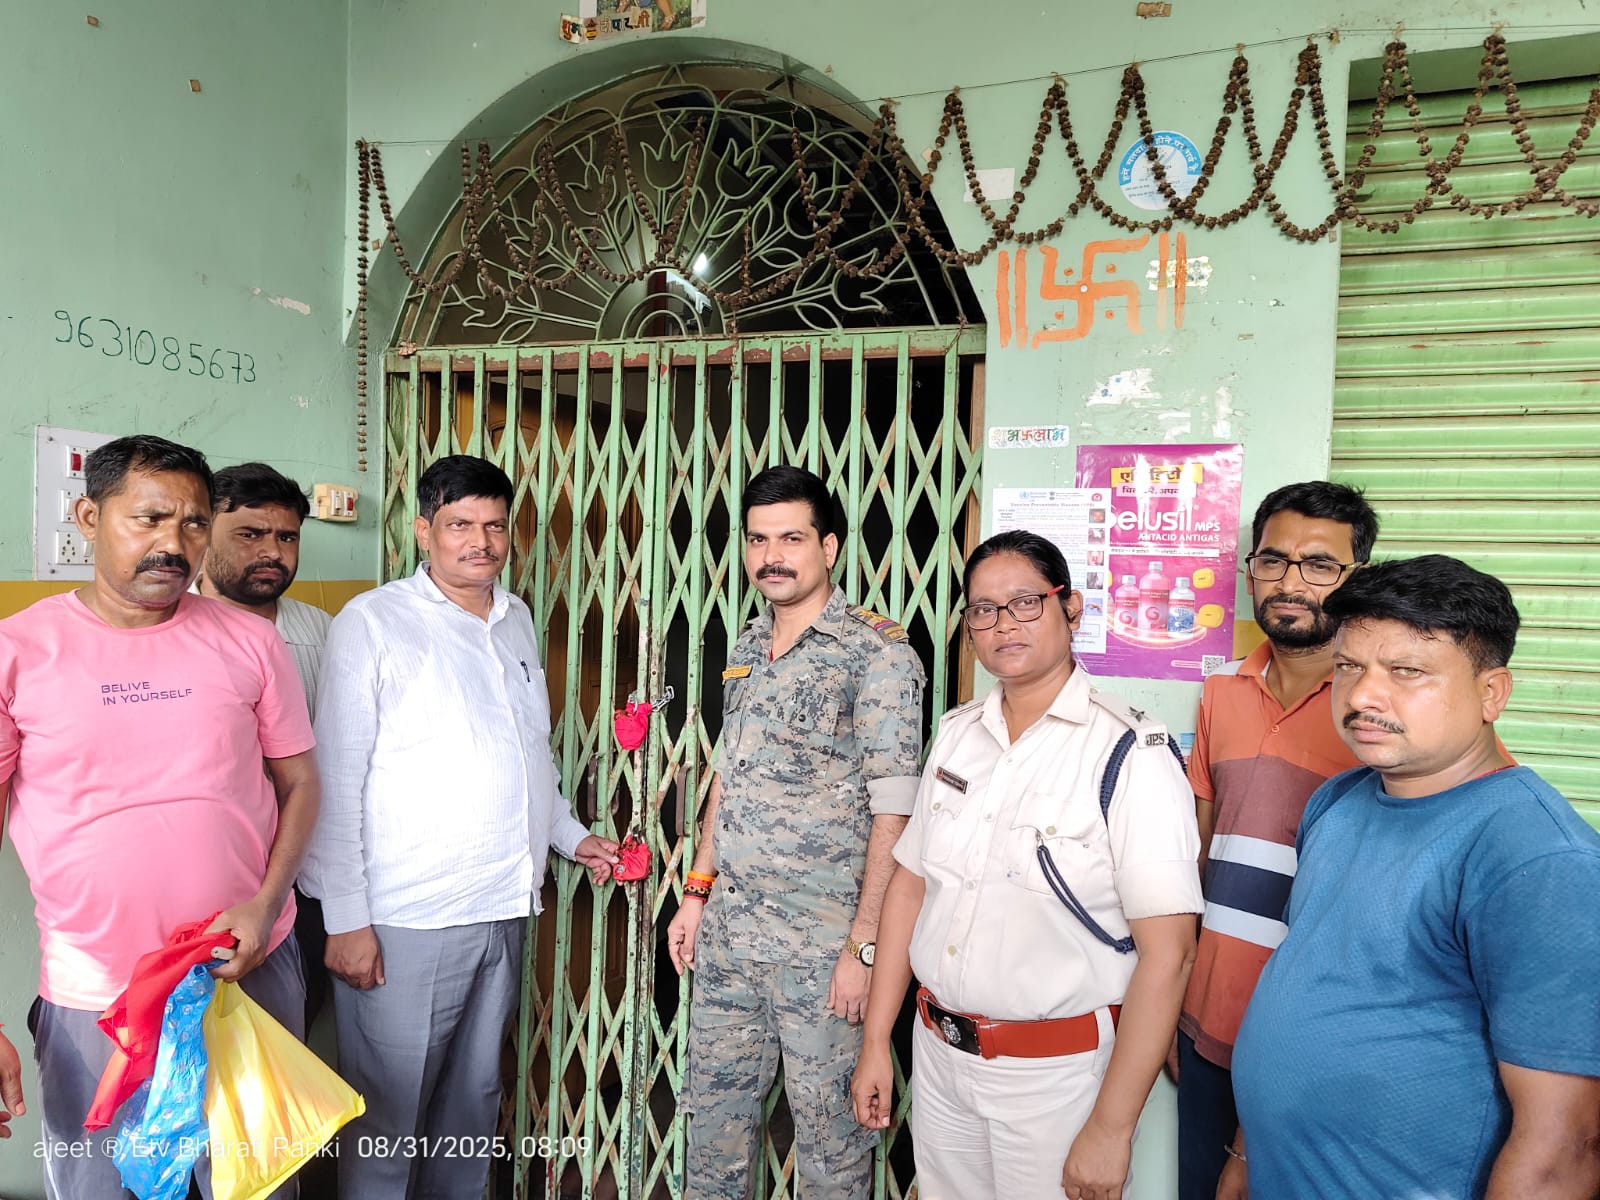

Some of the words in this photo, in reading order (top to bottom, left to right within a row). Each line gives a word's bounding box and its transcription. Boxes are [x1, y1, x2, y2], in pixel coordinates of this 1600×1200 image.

[54, 310, 256, 384] 9631085673
[1194, 521, 1220, 532] MPS
[1138, 533, 1177, 542] ANTACID
[1181, 534, 1220, 543] ANTIGAS
[101, 681, 150, 694] BELIVE
[103, 696, 116, 706] IN
[121, 688, 192, 704] YOURSELF
